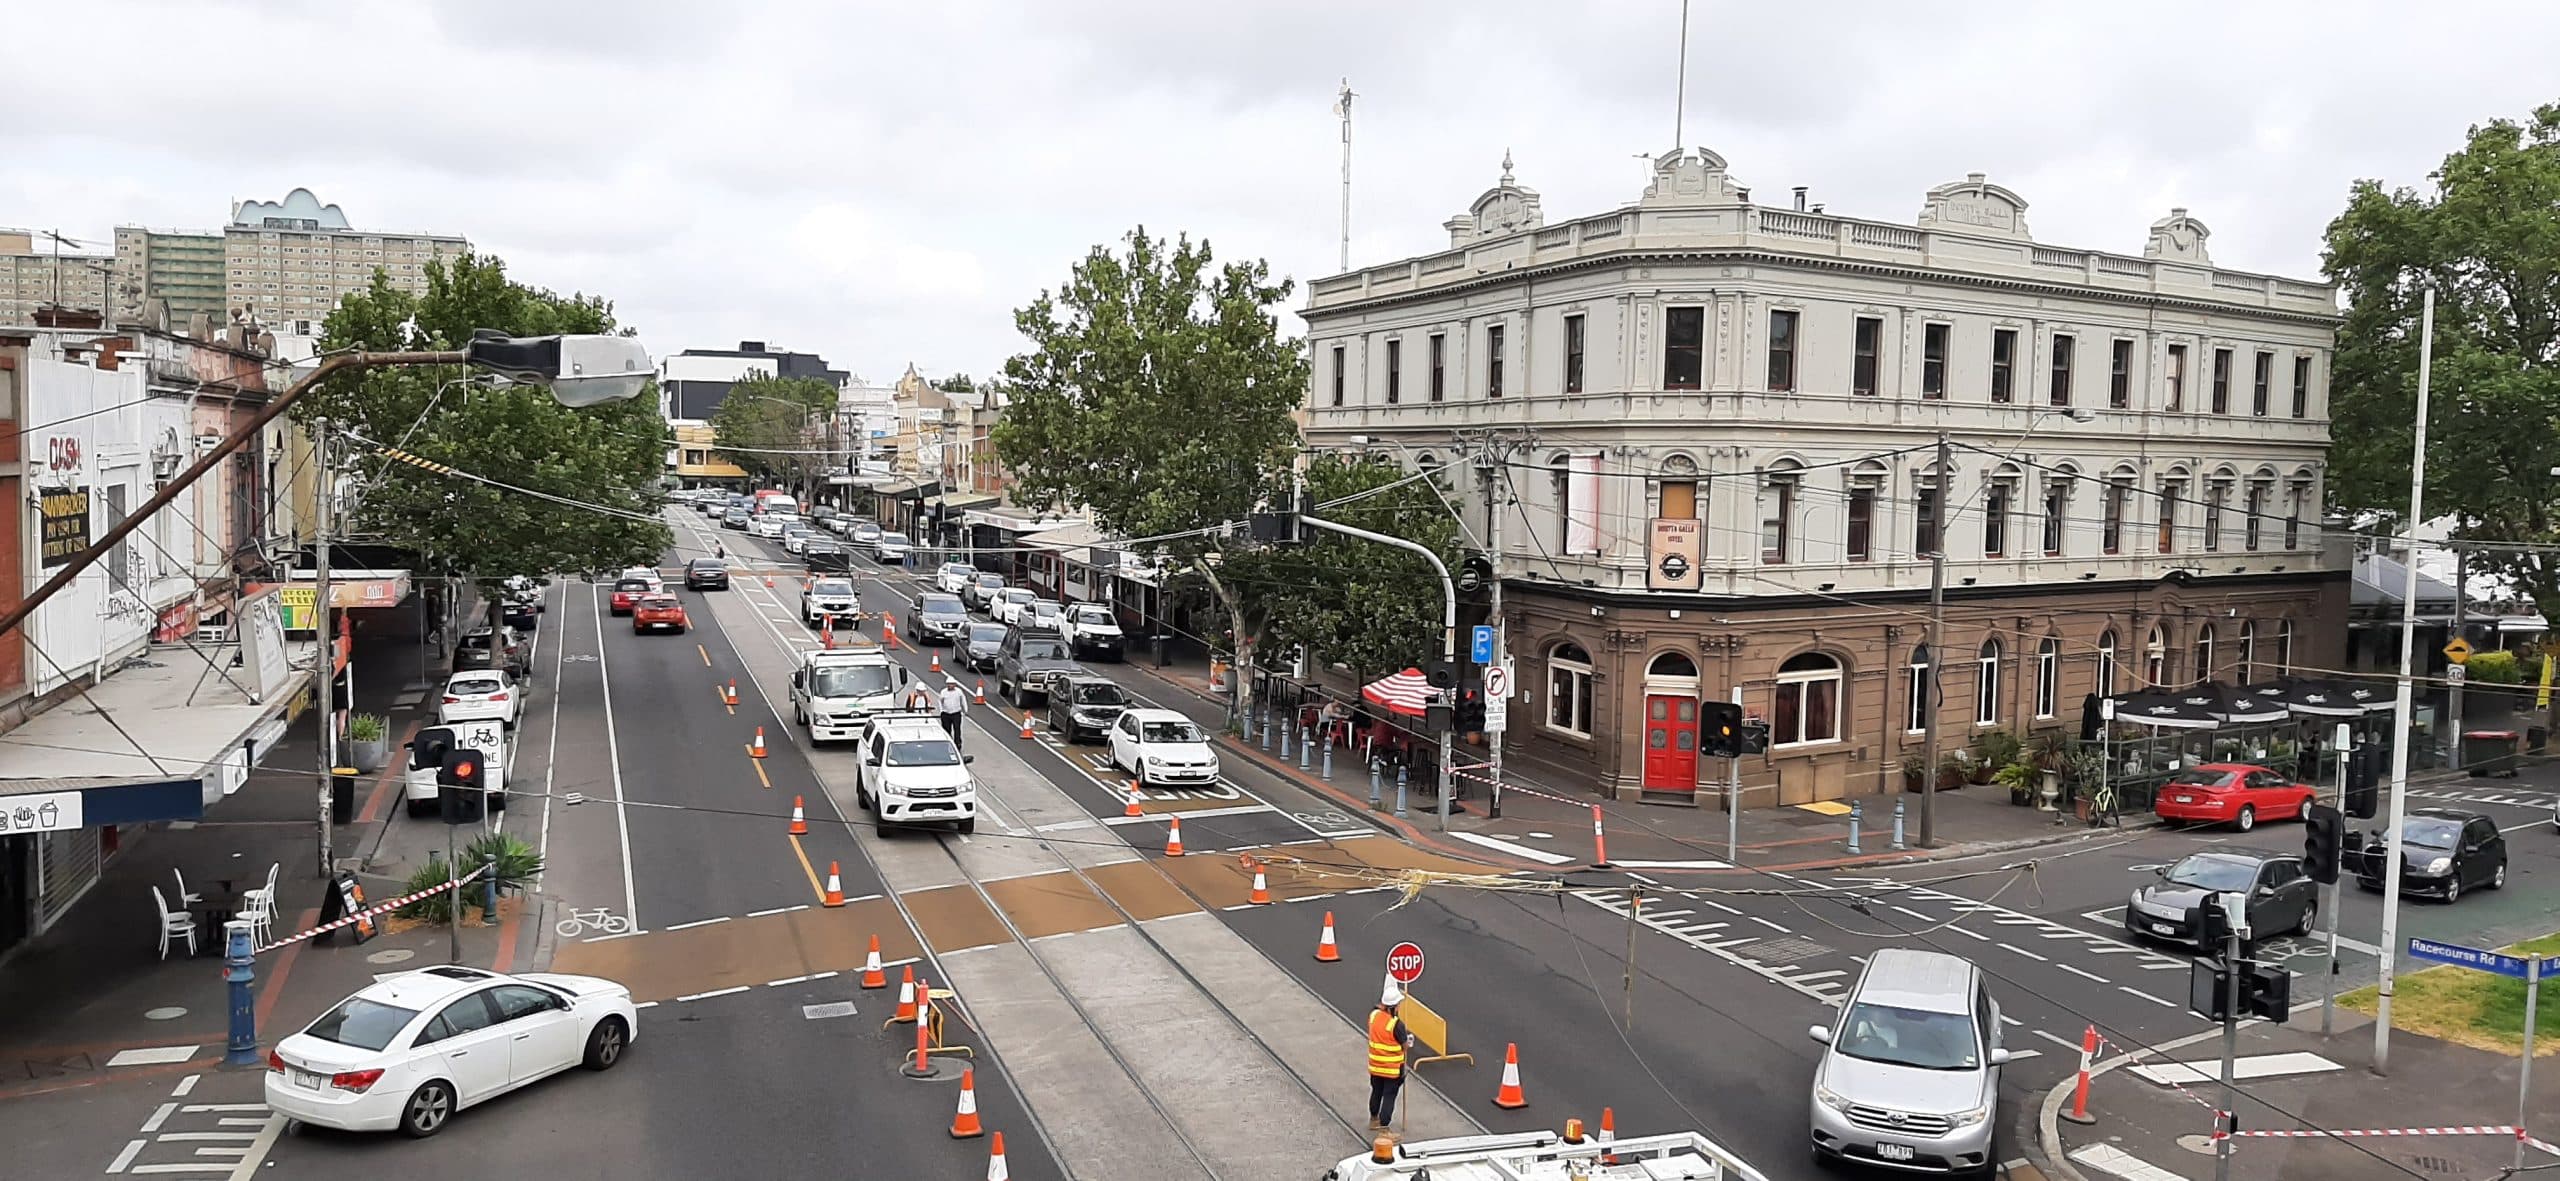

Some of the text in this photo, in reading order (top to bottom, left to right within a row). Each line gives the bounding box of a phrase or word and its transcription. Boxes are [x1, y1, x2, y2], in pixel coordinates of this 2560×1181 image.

[1390, 955, 1421, 971] STOP
[2411, 939, 2477, 962] Racecourse
[2480, 952, 2497, 966] Rd
